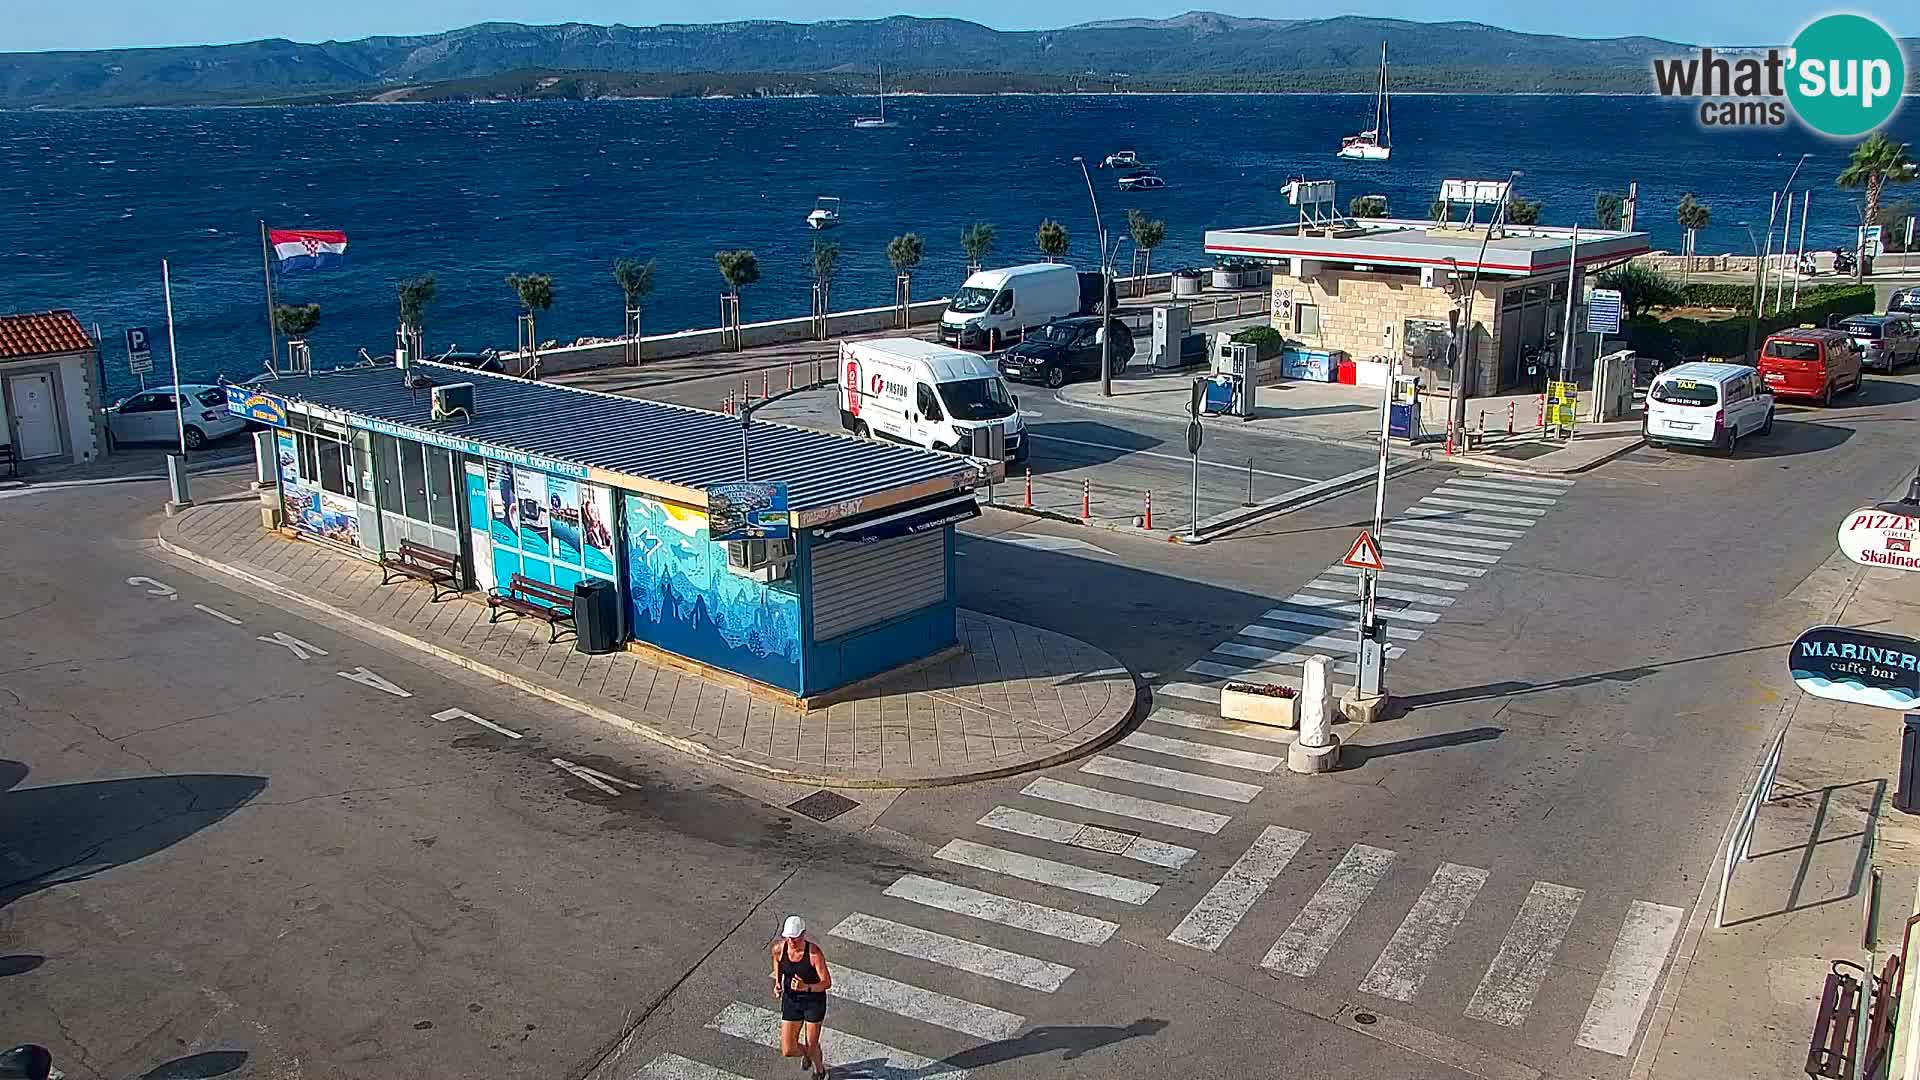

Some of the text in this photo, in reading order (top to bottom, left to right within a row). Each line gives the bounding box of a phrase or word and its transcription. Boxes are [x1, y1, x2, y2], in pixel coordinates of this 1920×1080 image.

[131, 330, 144, 349] P
[1677, 380, 1696, 390] TAXI
[437, 436, 469, 451] POSTAJA
[479, 446, 495, 457] BUS
[495, 449, 528, 464] STATION
[529, 456, 555, 470] TICKET
[556, 462, 584, 476] OFFICE
[1850, 514, 1920, 533] PIZZE
[1800, 641, 1920, 673] MARINER
[1830, 661, 1898, 681] caffe bar
